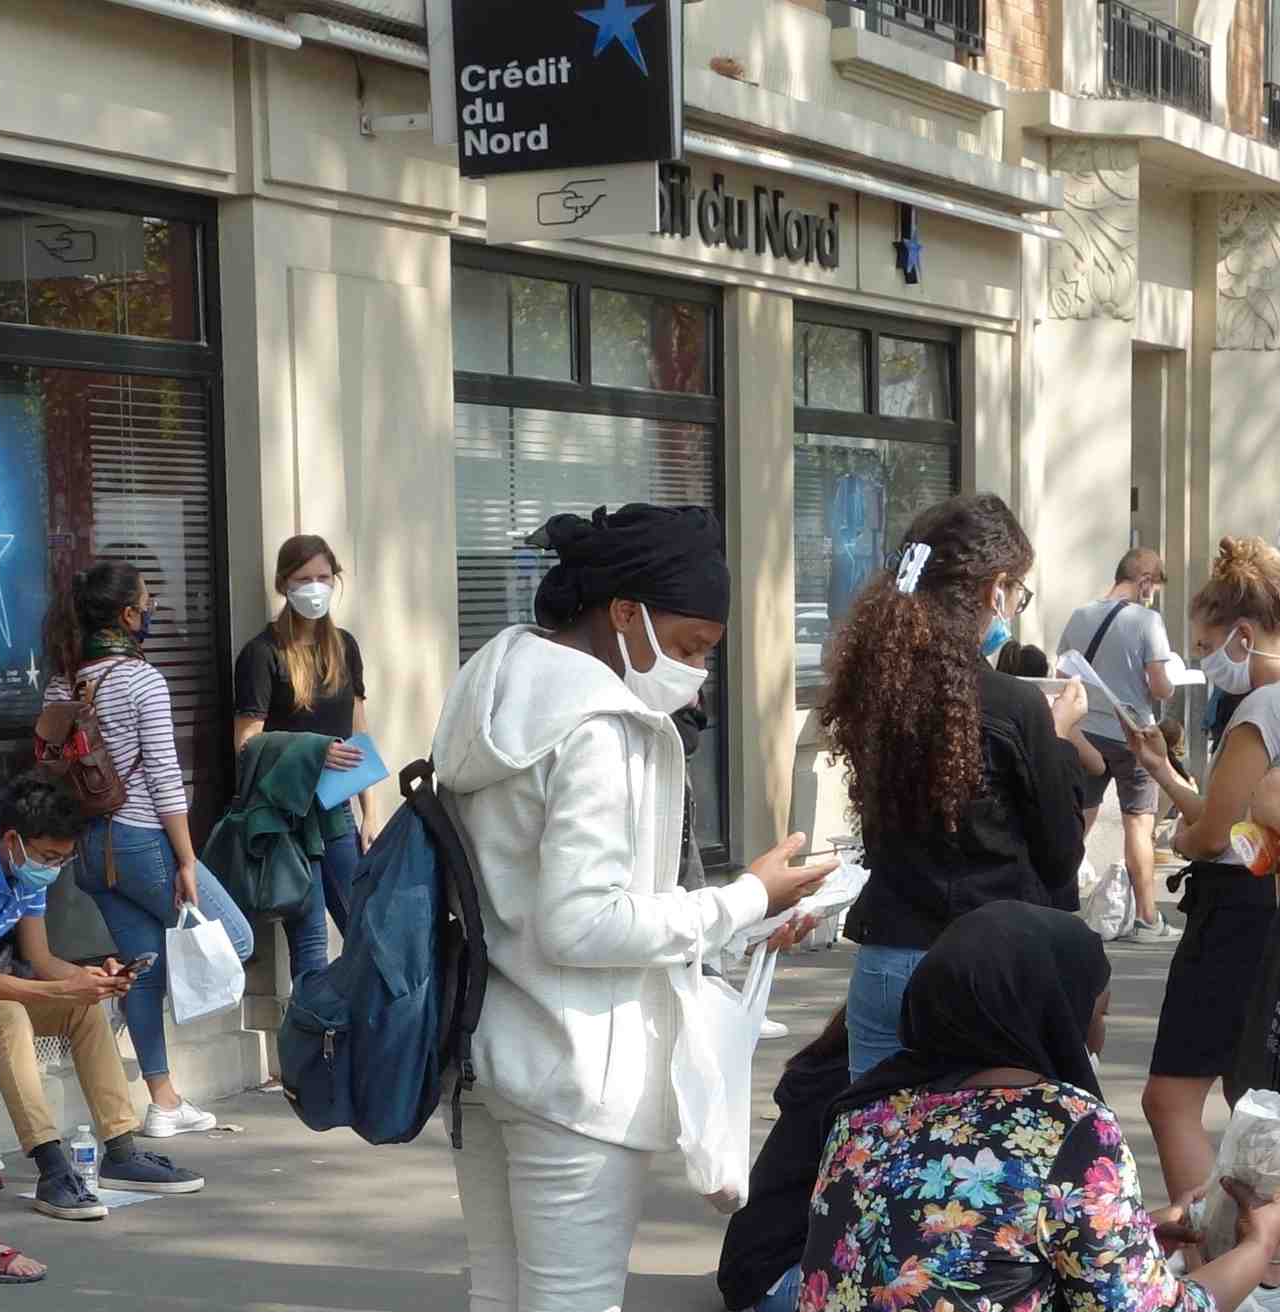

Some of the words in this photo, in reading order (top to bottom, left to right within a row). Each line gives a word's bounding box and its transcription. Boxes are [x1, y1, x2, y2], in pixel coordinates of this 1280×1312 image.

[460, 56, 573, 93] Crédit
[461, 98, 505, 125] du
[464, 123, 550, 156] Nord
[697, 173, 749, 250] du
[754, 184, 840, 270] Nord
